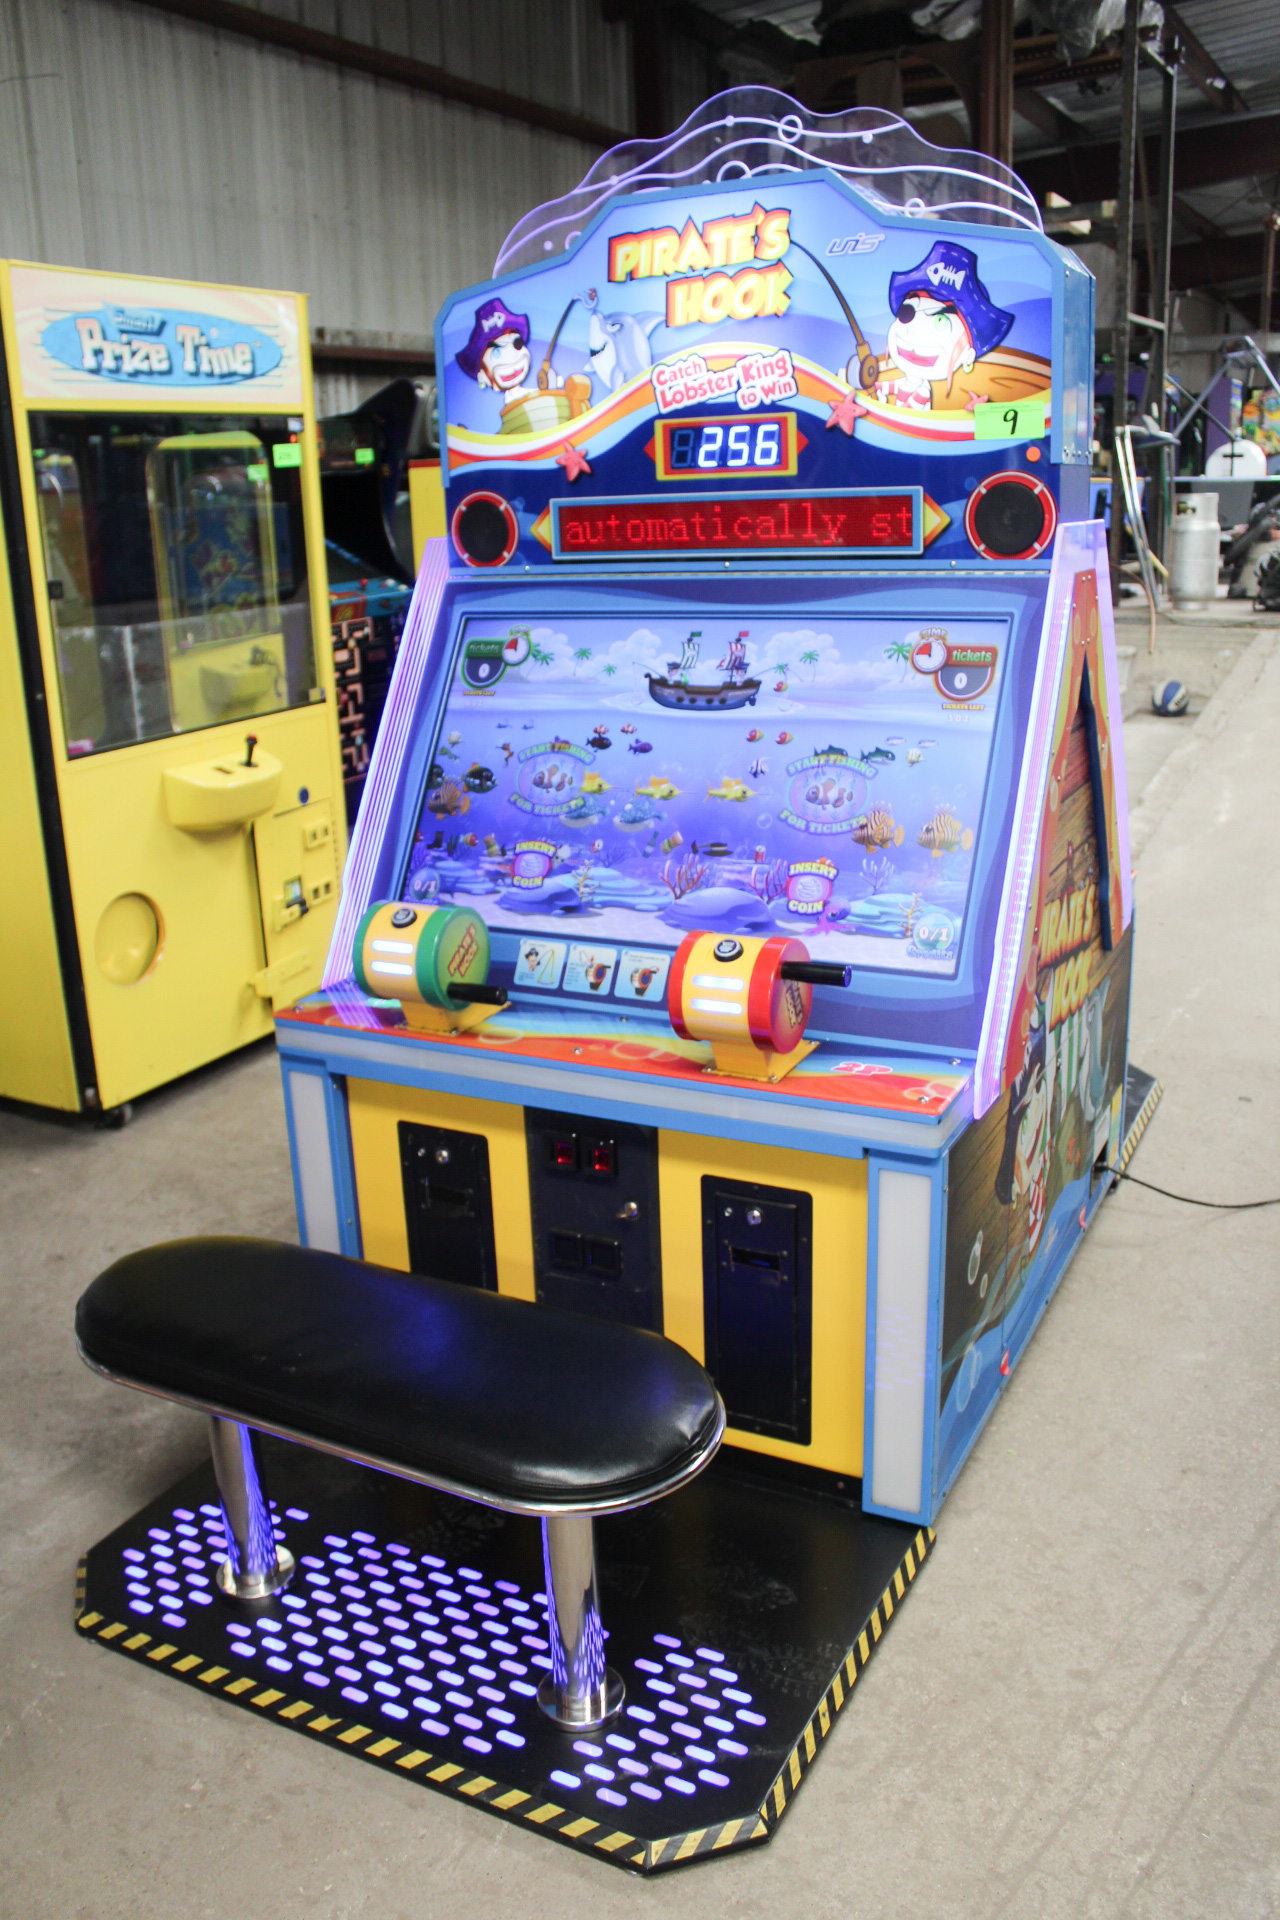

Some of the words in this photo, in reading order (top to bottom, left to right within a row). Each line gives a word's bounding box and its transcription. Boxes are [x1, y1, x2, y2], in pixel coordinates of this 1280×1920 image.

[608, 201, 791, 282] PIRATE'S
[666, 258, 793, 328] HOOK
[76, 318, 170, 374] Prize
[176, 324, 254, 377] Time
[656, 360, 703, 386] Catch
[741, 355, 789, 384] King
[660, 373, 735, 409] Lobster
[741, 391, 758, 406] to
[761, 379, 793, 399] Win
[1003, 408, 1018, 435] 9
[698, 424, 779, 467] 256
[566, 503, 847, 544] automatically
[872, 507, 912, 539] st
[952, 649, 992, 662] tickets
[478, 663, 490, 679] 0
[954, 672, 967, 689] 0
[788, 755, 827, 775] START
[828, 755, 876, 777] FISHING
[510, 793, 532, 811] FOR
[779, 809, 806, 830] FOR
[808, 814, 867, 833] TICKETS
[515, 841, 556, 857] INSERT
[513, 876, 543, 888] COIN
[789, 862, 838, 879] INSERT
[788, 900, 824, 914] COIN
[918, 925, 949, 942] 0/1
[1049, 948, 1093, 1033] HOOK
[830, 1061, 893, 1076] 2P
